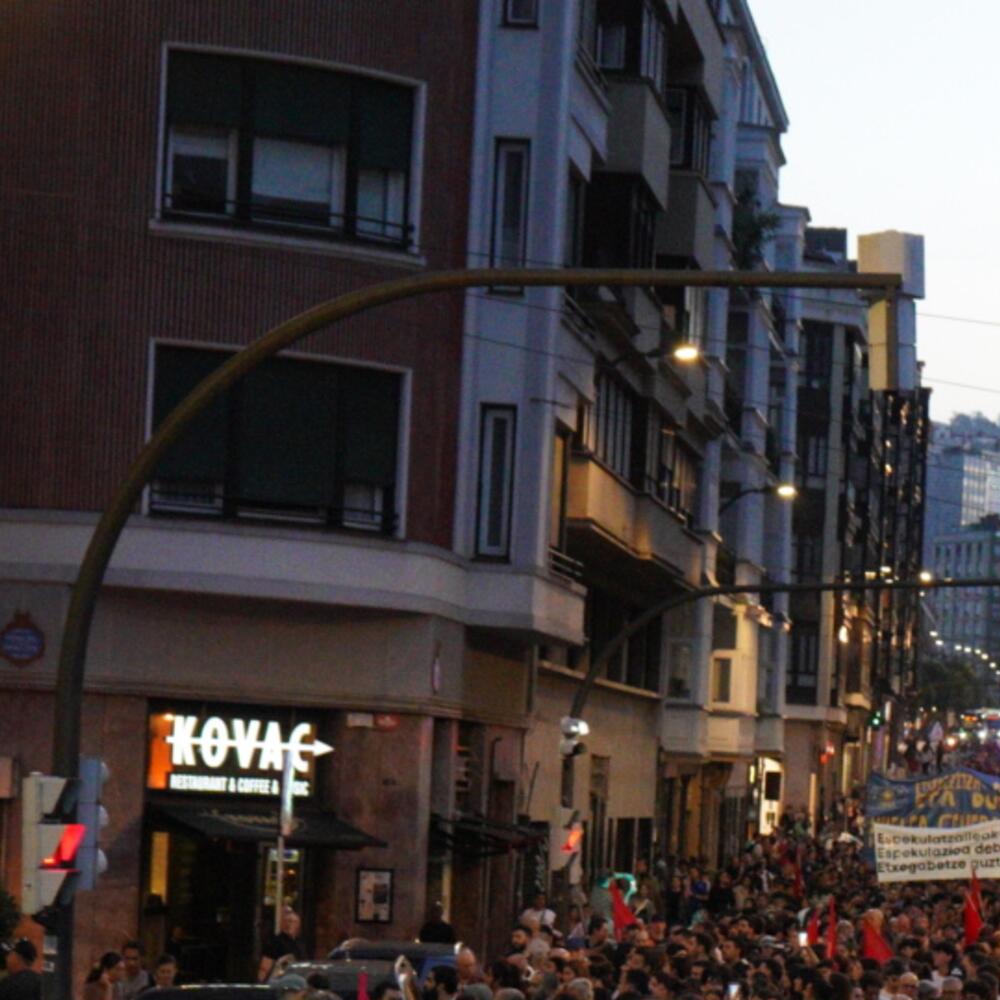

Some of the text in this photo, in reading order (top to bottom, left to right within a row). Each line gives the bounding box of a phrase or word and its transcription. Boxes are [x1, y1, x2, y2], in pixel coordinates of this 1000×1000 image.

[172, 714, 310, 773] KOVAC
[877, 845, 970, 860] Espekulazioa
[877, 858, 966, 873] Etxegabetze
